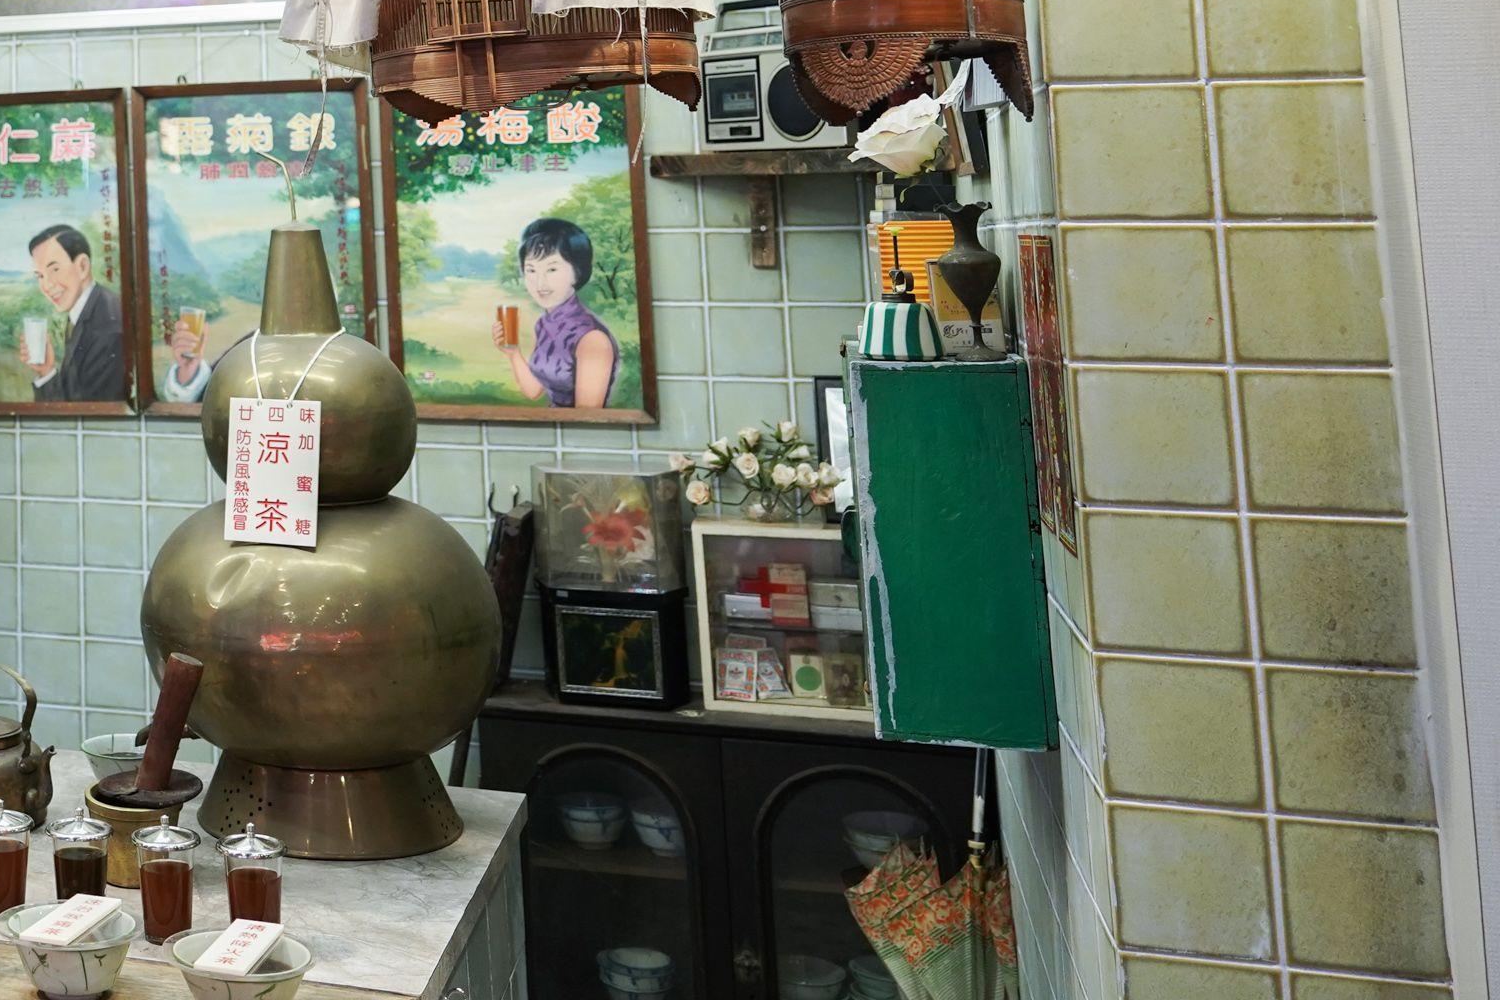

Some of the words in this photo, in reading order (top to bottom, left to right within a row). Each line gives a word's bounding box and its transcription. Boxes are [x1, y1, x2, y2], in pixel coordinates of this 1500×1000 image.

[233, 429, 252, 531] 防治風熱感冒
[255, 432, 290, 532] 涼茶
